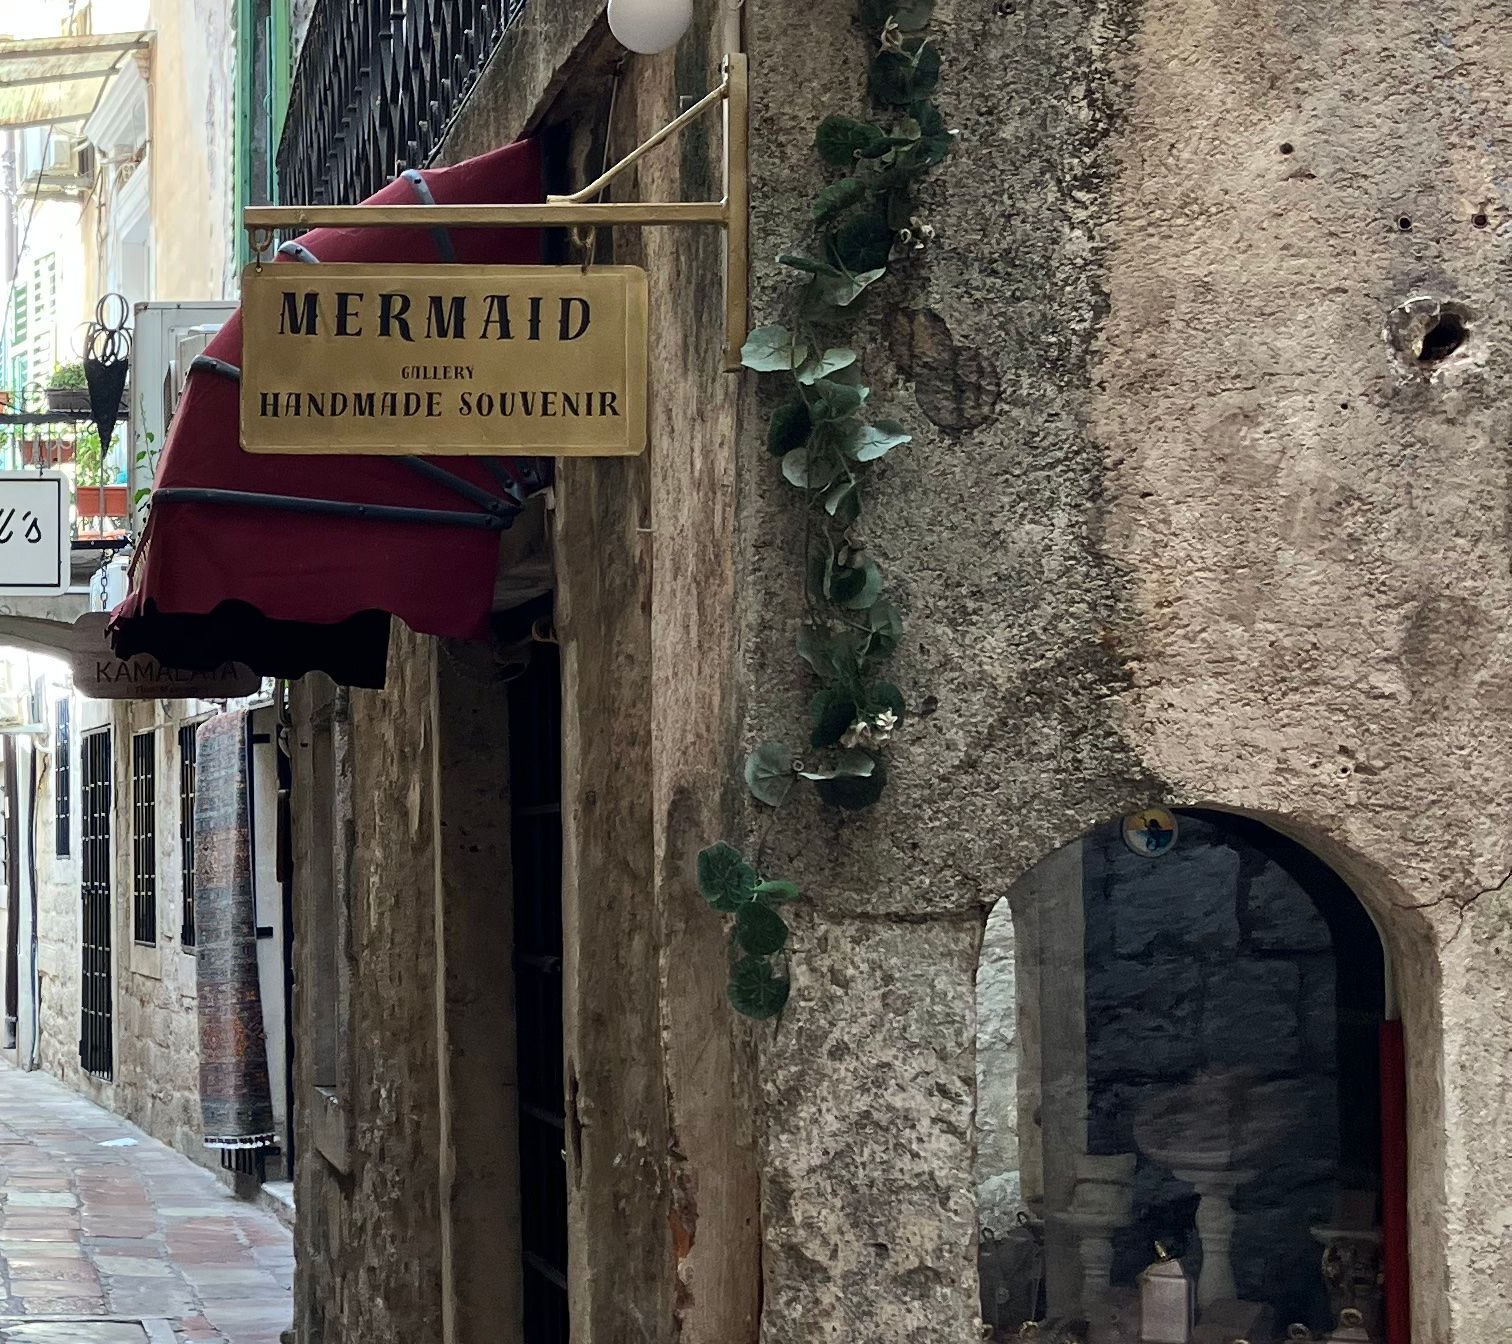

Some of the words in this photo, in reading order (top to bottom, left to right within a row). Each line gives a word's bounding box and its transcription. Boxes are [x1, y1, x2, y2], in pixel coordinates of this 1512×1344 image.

[277, 290, 592, 343] MERMAID
[401, 364, 475, 381] GALLERY
[259, 390, 443, 418] HANDMADE
[458, 390, 621, 418] SOUVENIR
